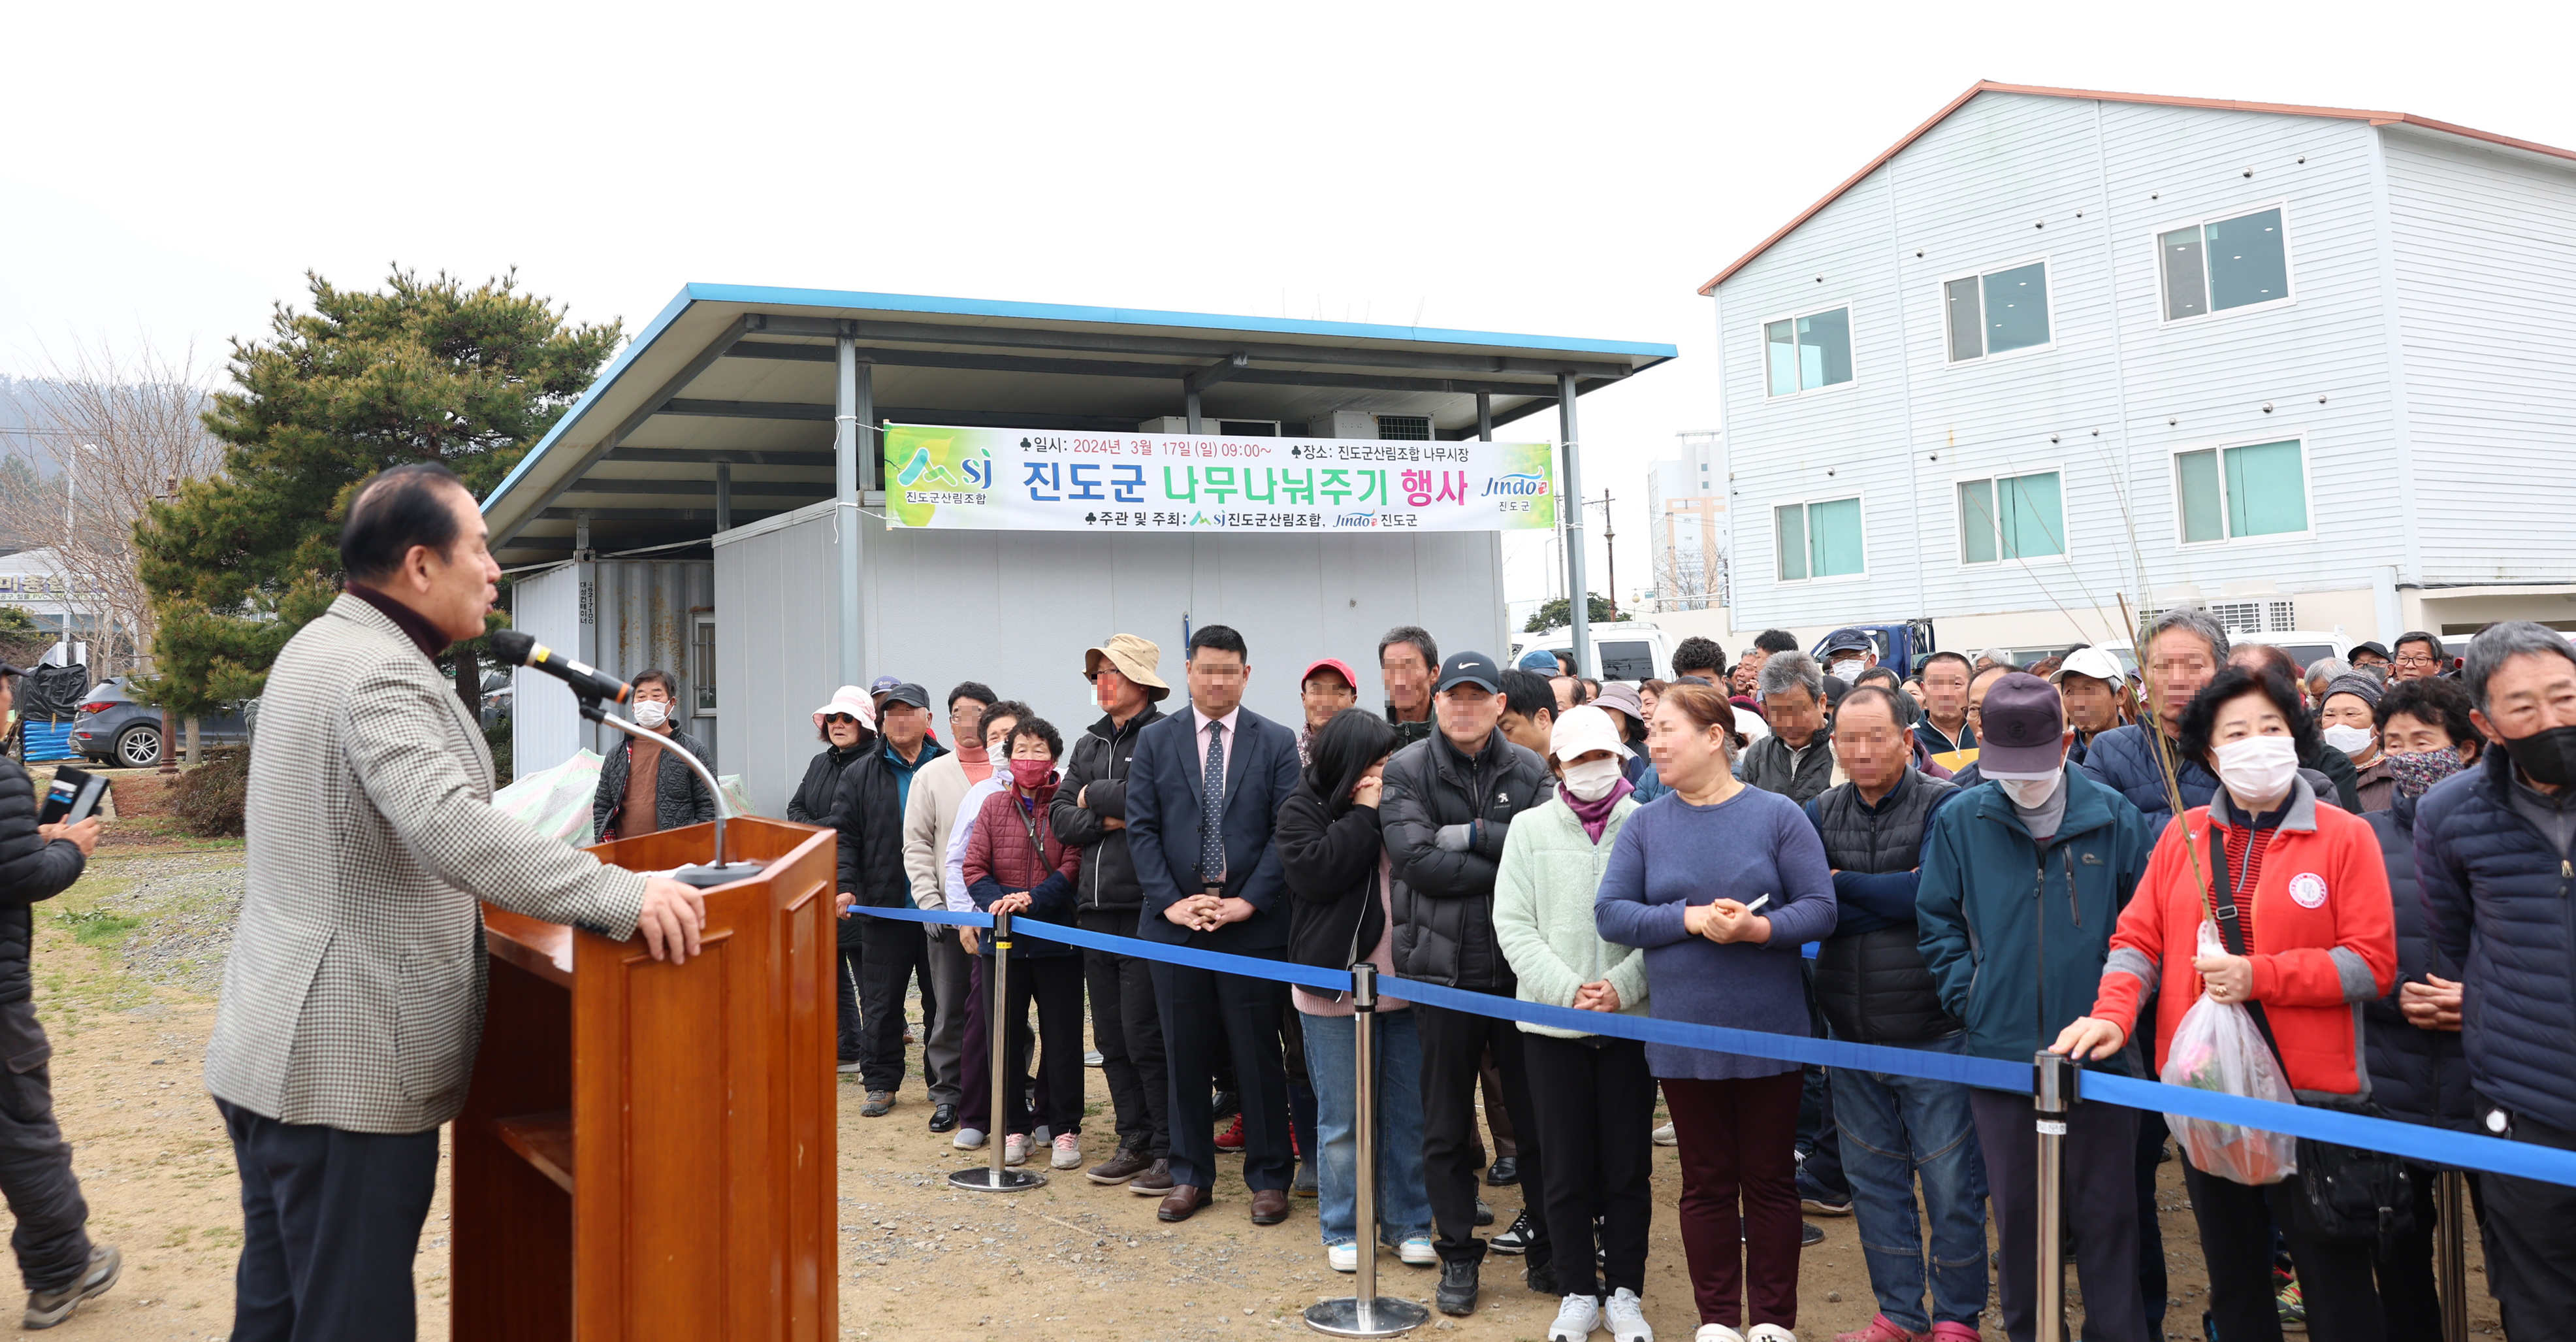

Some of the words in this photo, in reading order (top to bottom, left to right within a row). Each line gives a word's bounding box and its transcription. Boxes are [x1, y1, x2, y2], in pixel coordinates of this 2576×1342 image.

[1034, 436, 1067, 453] 일시:
[1074, 439, 1121, 454] 2024년
[1131, 439, 1151, 455] 3월
[1221, 444, 1271, 457] 09:00~
[1304, 445, 1332, 459] 장소:
[1338, 446, 1420, 461] 진도군산림조합
[1424, 448, 1469, 462] 나무시장
[1023, 462, 1146, 502] 진도군
[1163, 466, 1387, 506] 나무나눠주기
[1401, 468, 1468, 507] 행사
[1481, 477, 1537, 497] Jindo
[907, 491, 986, 505] 진도군산림조합
[1499, 501, 1529, 512] 진도군
[1099, 512, 1128, 526] 주관
[1135, 512, 1146, 526] 및
[1152, 512, 1185, 526] 주최:
[1228, 513, 1325, 528] 진도군산림조합,
[1332, 515, 1370, 528] Jindo
[1381, 514, 1417, 527] 진도군
